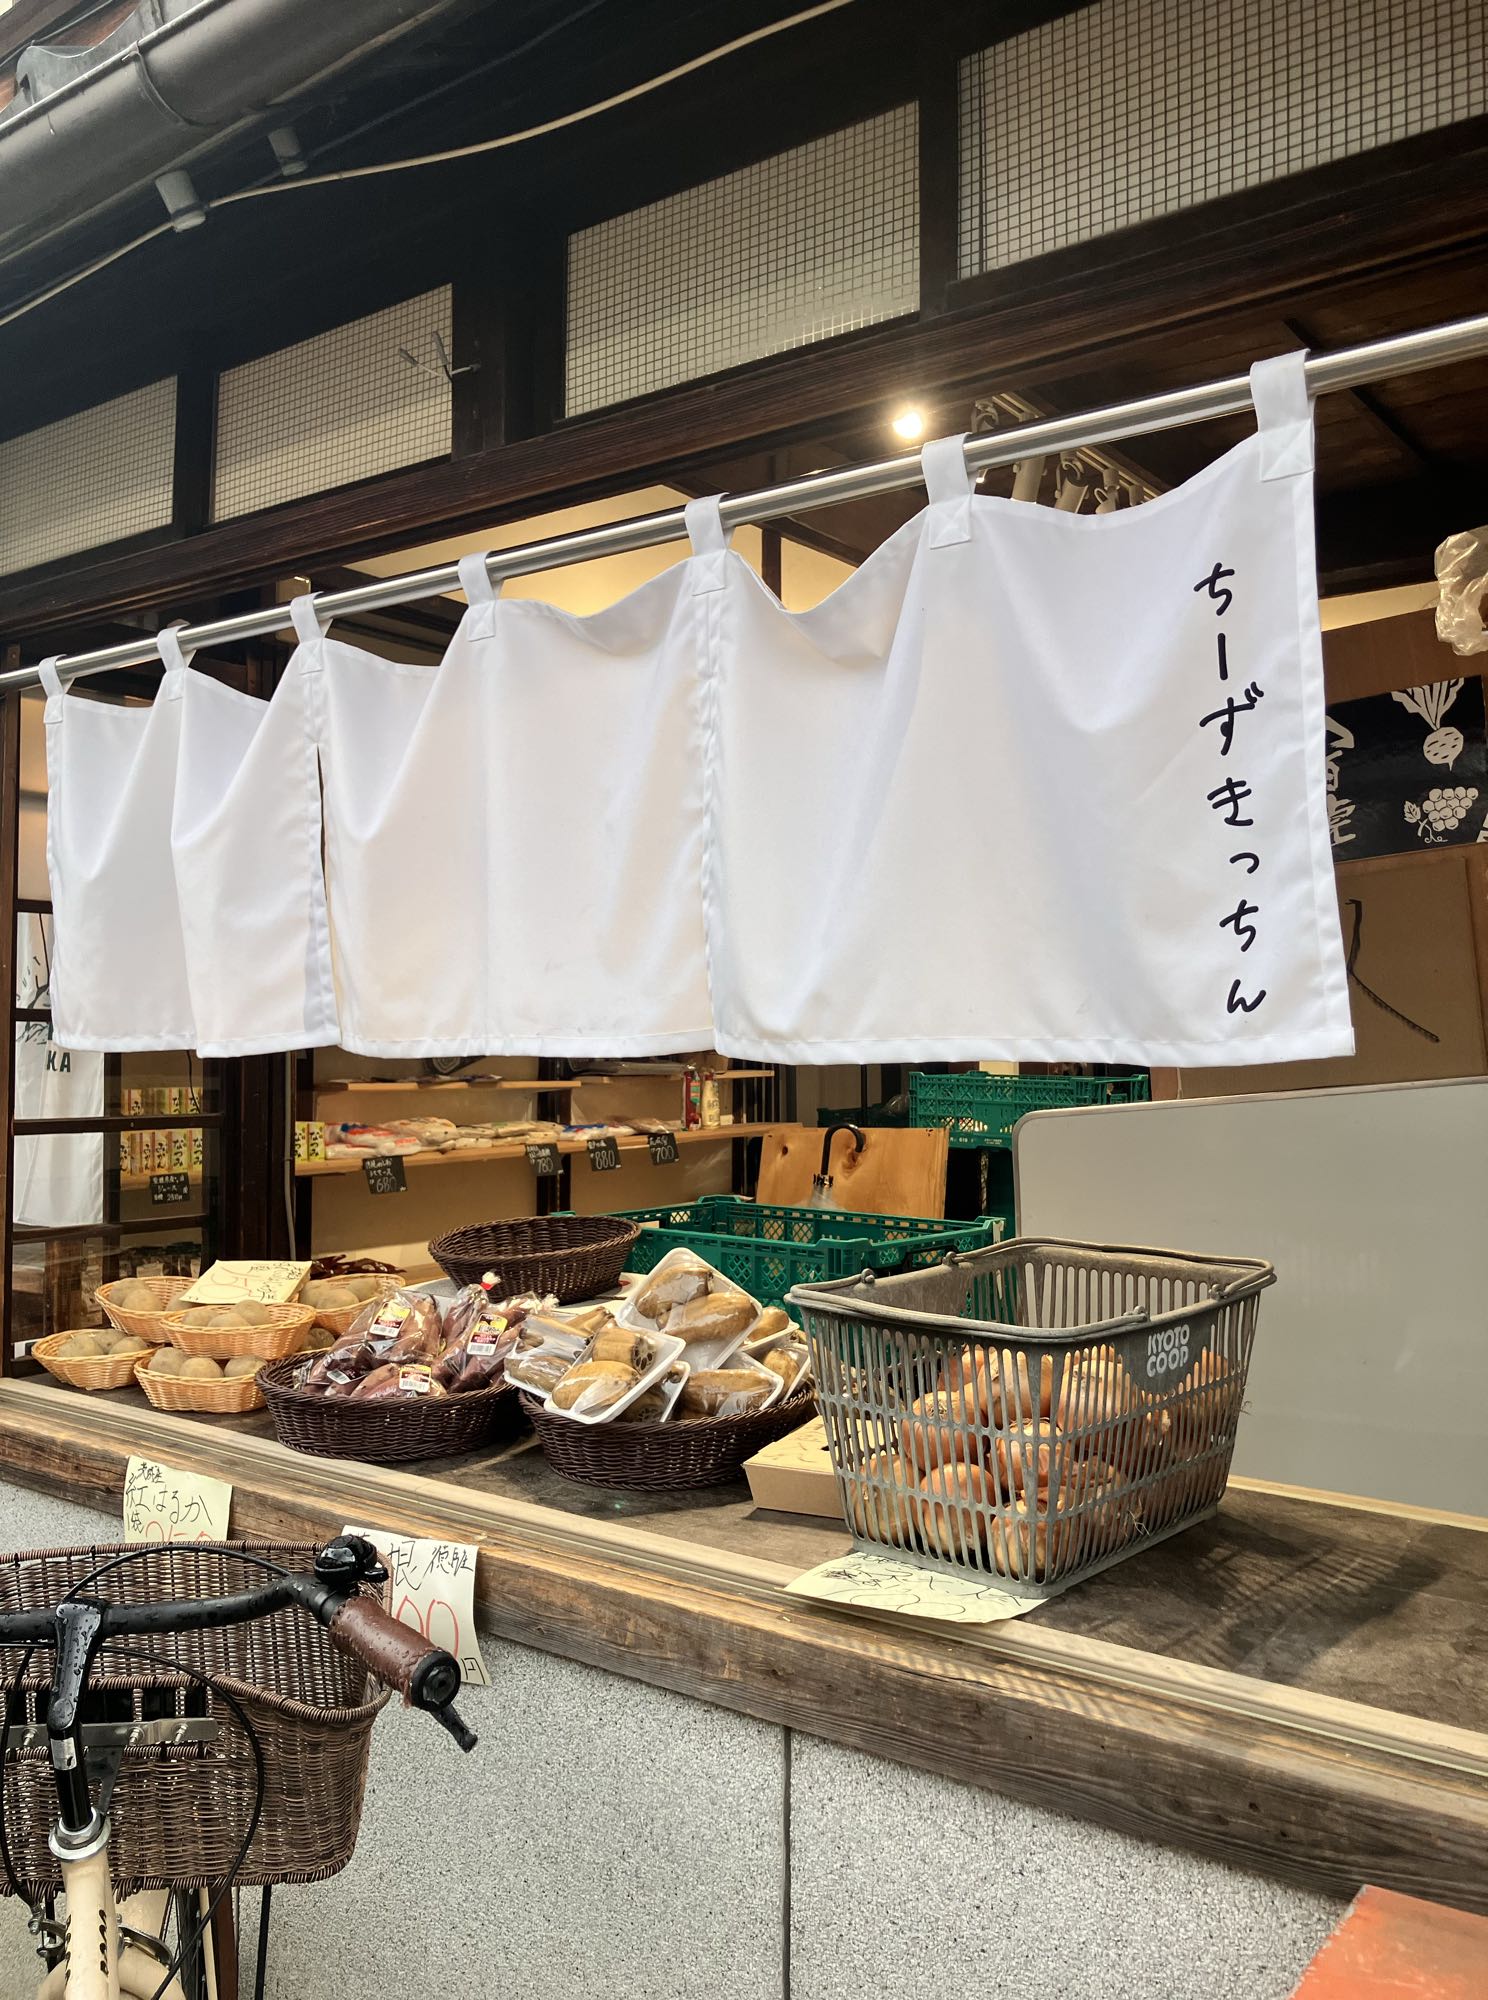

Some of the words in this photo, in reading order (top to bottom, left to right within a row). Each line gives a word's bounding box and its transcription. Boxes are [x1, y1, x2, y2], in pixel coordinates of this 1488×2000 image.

[1193, 560, 1267, 1015] ちーずきっちん
[536, 1156, 554, 1174] 780
[594, 1150, 616, 1170] 880
[1147, 1324, 1190, 1356] KYOTO
[1146, 1346, 1189, 1378] COOP
[126, 1473, 213, 1526] 紅はるか
